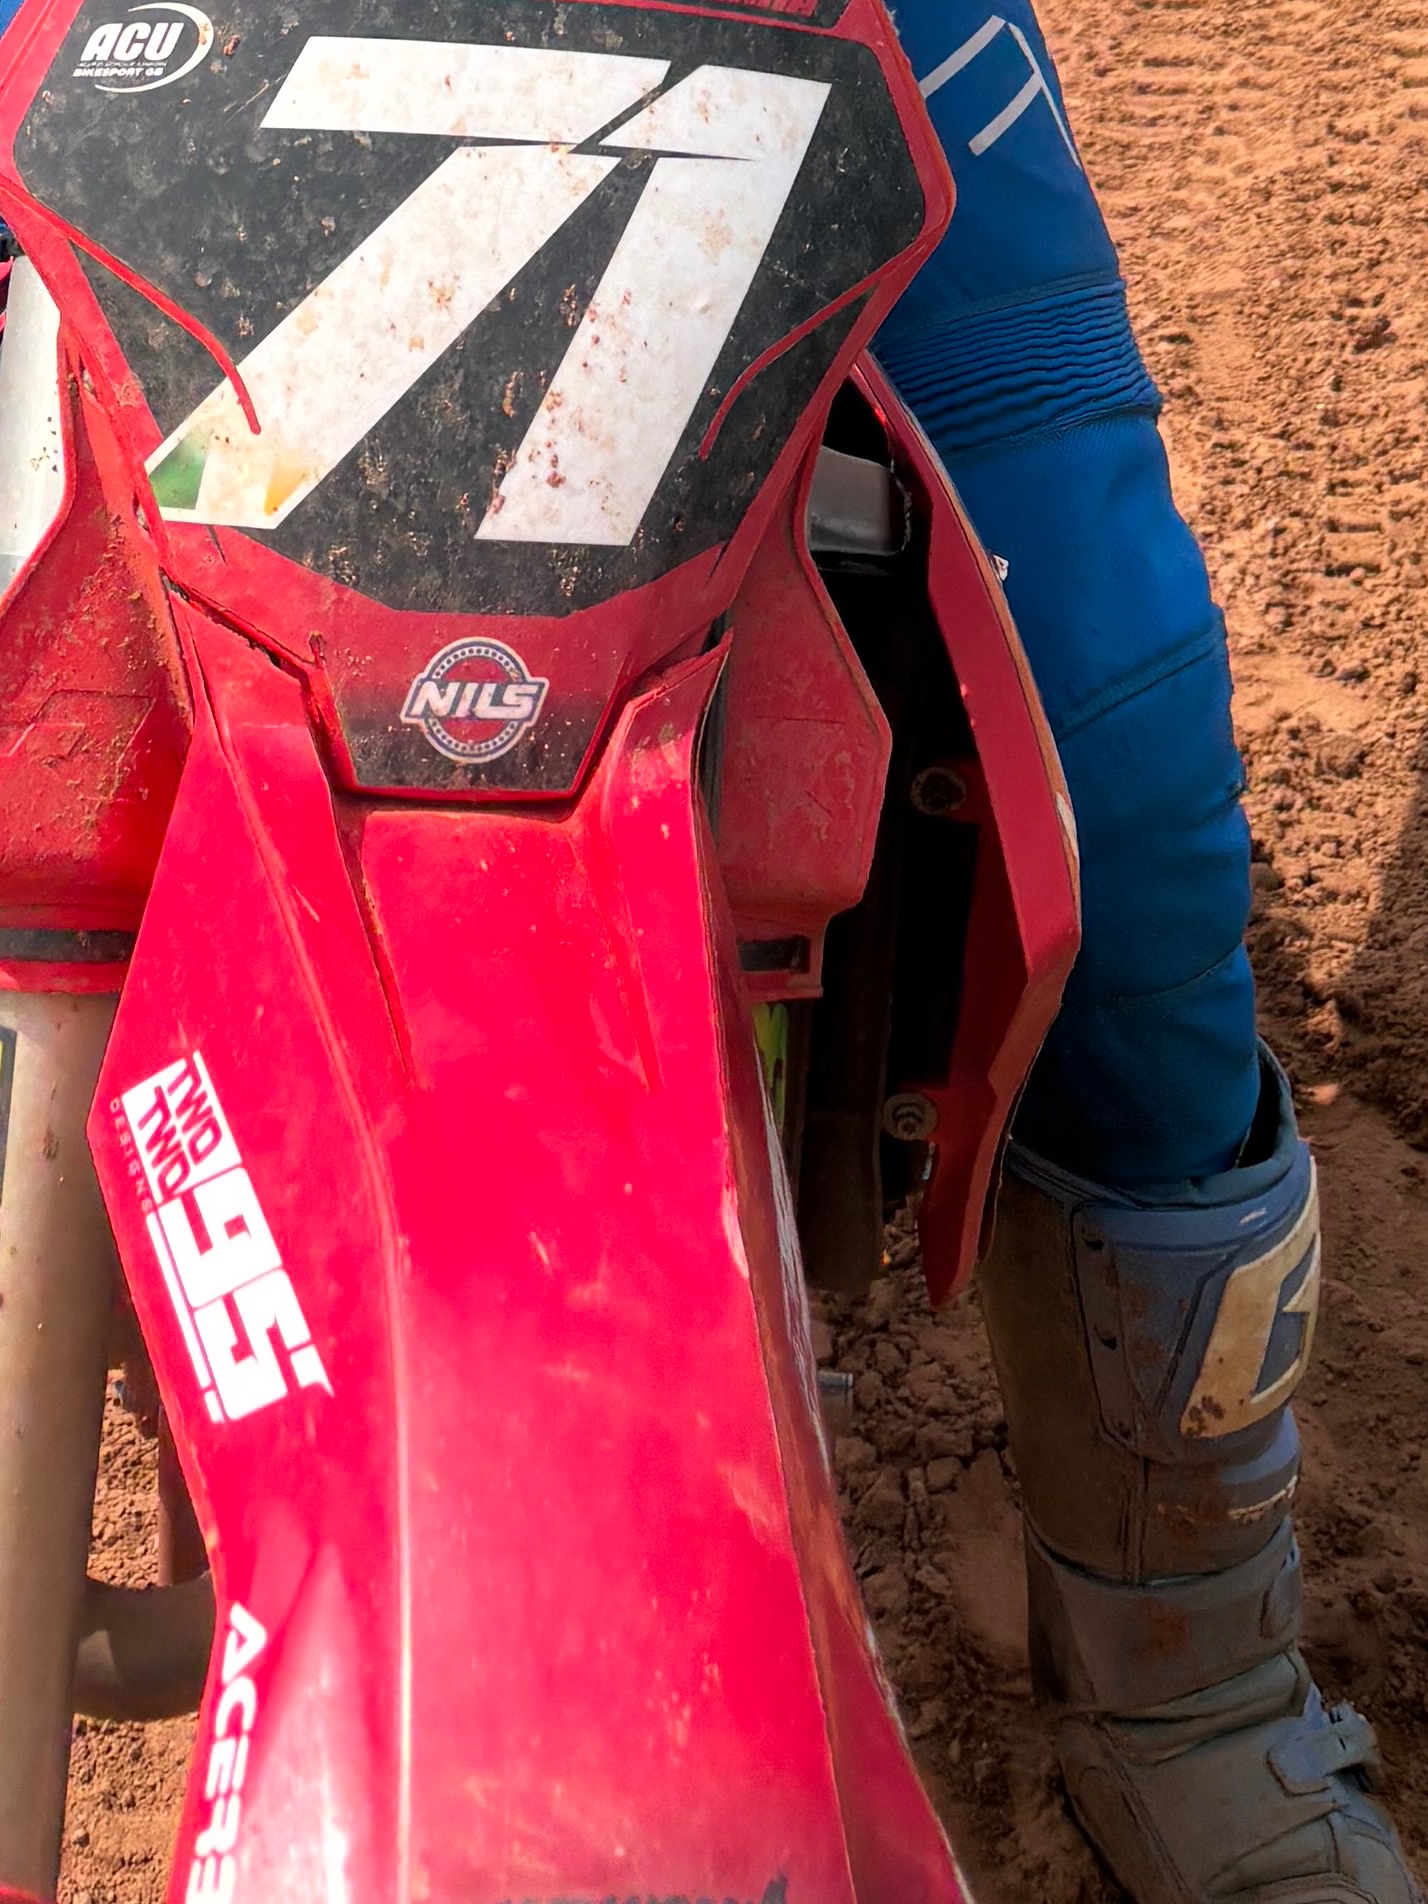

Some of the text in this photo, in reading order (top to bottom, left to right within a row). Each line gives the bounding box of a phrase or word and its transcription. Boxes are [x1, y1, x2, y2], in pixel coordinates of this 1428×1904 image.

[80, 21, 185, 62] ACU
[142, 35, 833, 547] 71
[409, 680, 539, 720] NILS
[108, 1095, 153, 1213] DESIGNS
[137, 1084, 191, 1200] TWO
[167, 1057, 223, 1167] TWO
